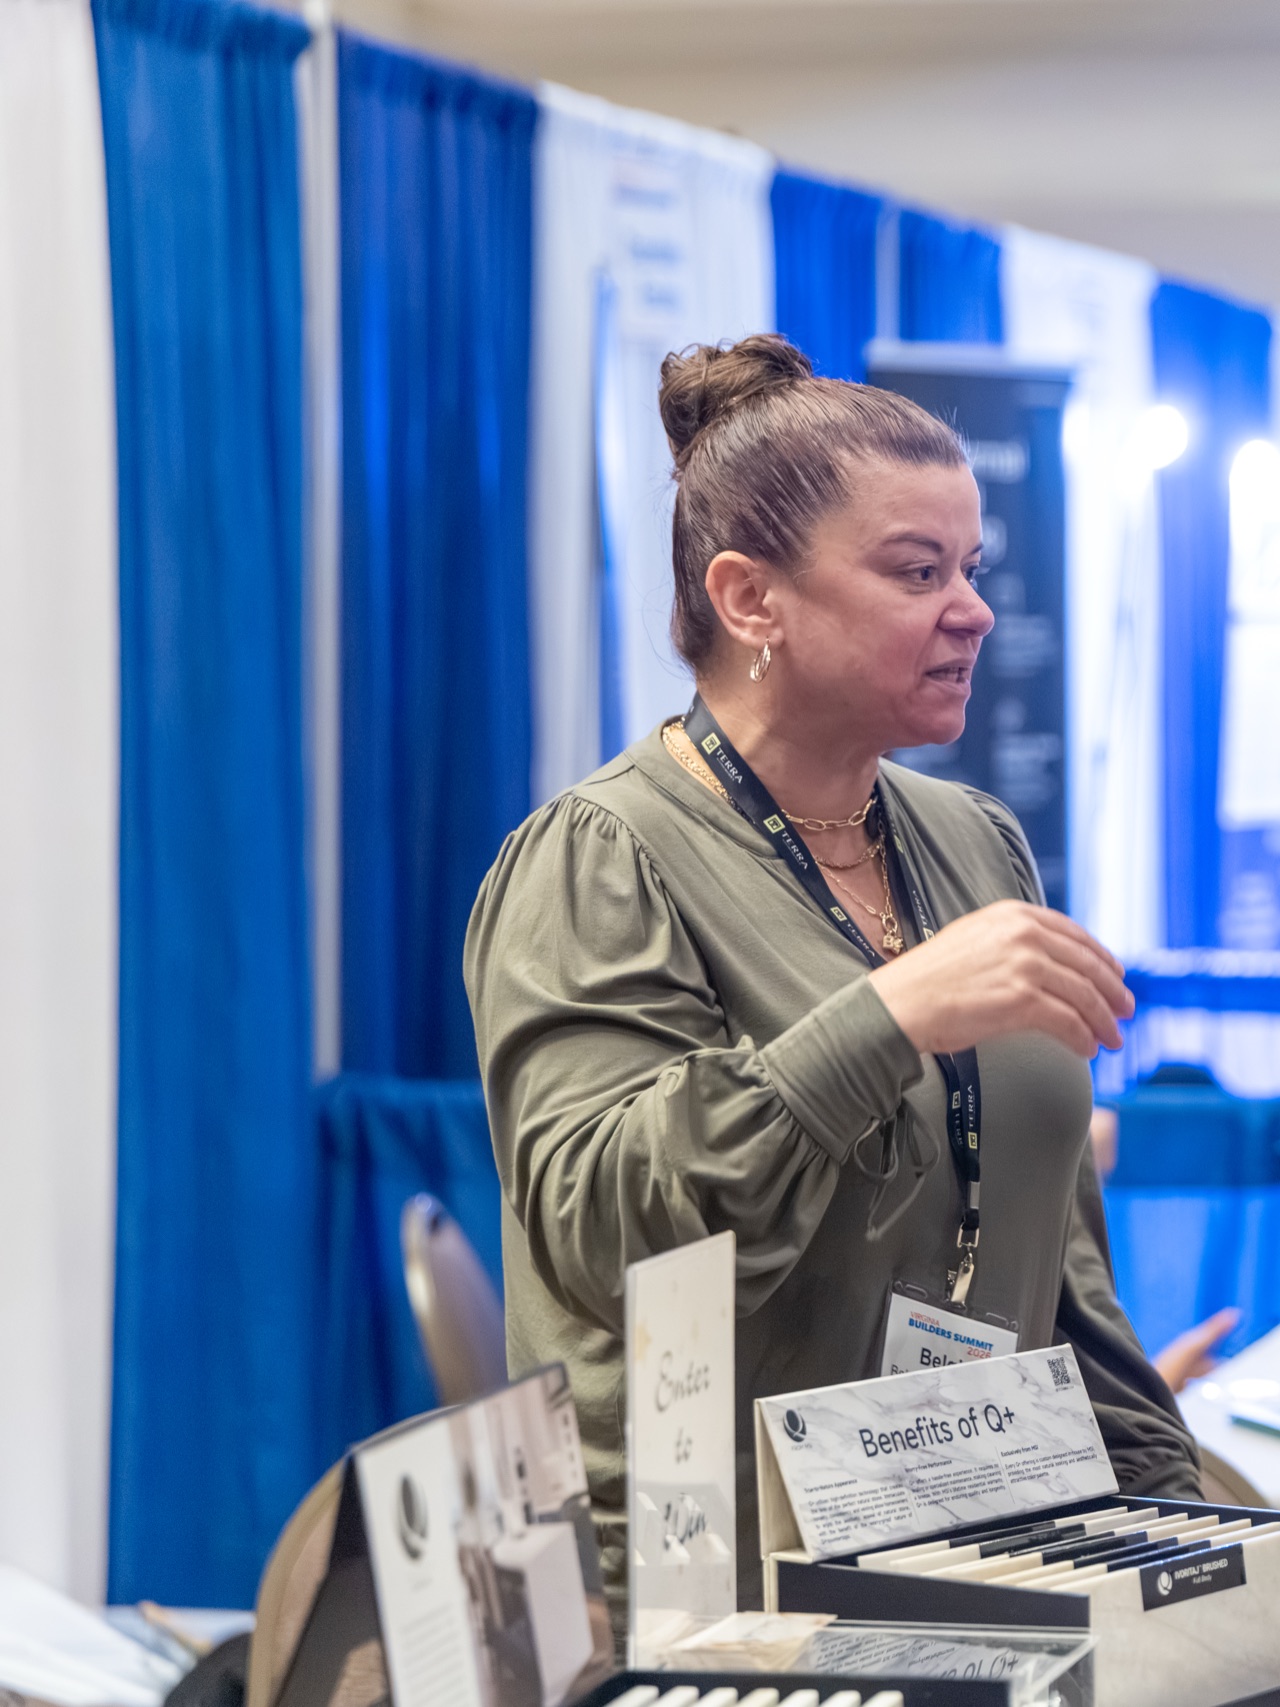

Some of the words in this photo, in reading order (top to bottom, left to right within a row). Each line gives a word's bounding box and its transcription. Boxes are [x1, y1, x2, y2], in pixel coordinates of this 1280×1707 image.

[715, 747, 743, 785] TERRA
[781, 831, 809, 870] TERRA
[967, 1084, 975, 1129] TERRA
[908, 1317, 952, 1340] BUILDERS
[953, 1332, 994, 1351] SUMMIT
[909, 1311, 941, 1327] VIRGINIA
[858, 1416, 954, 1458] Benefits
[957, 1406, 980, 1442] of
[983, 1403, 1016, 1434] Q+
[1000, 1448, 1021, 1457] Exclusively
[1202, 1557, 1229, 1573] BRUSHED
